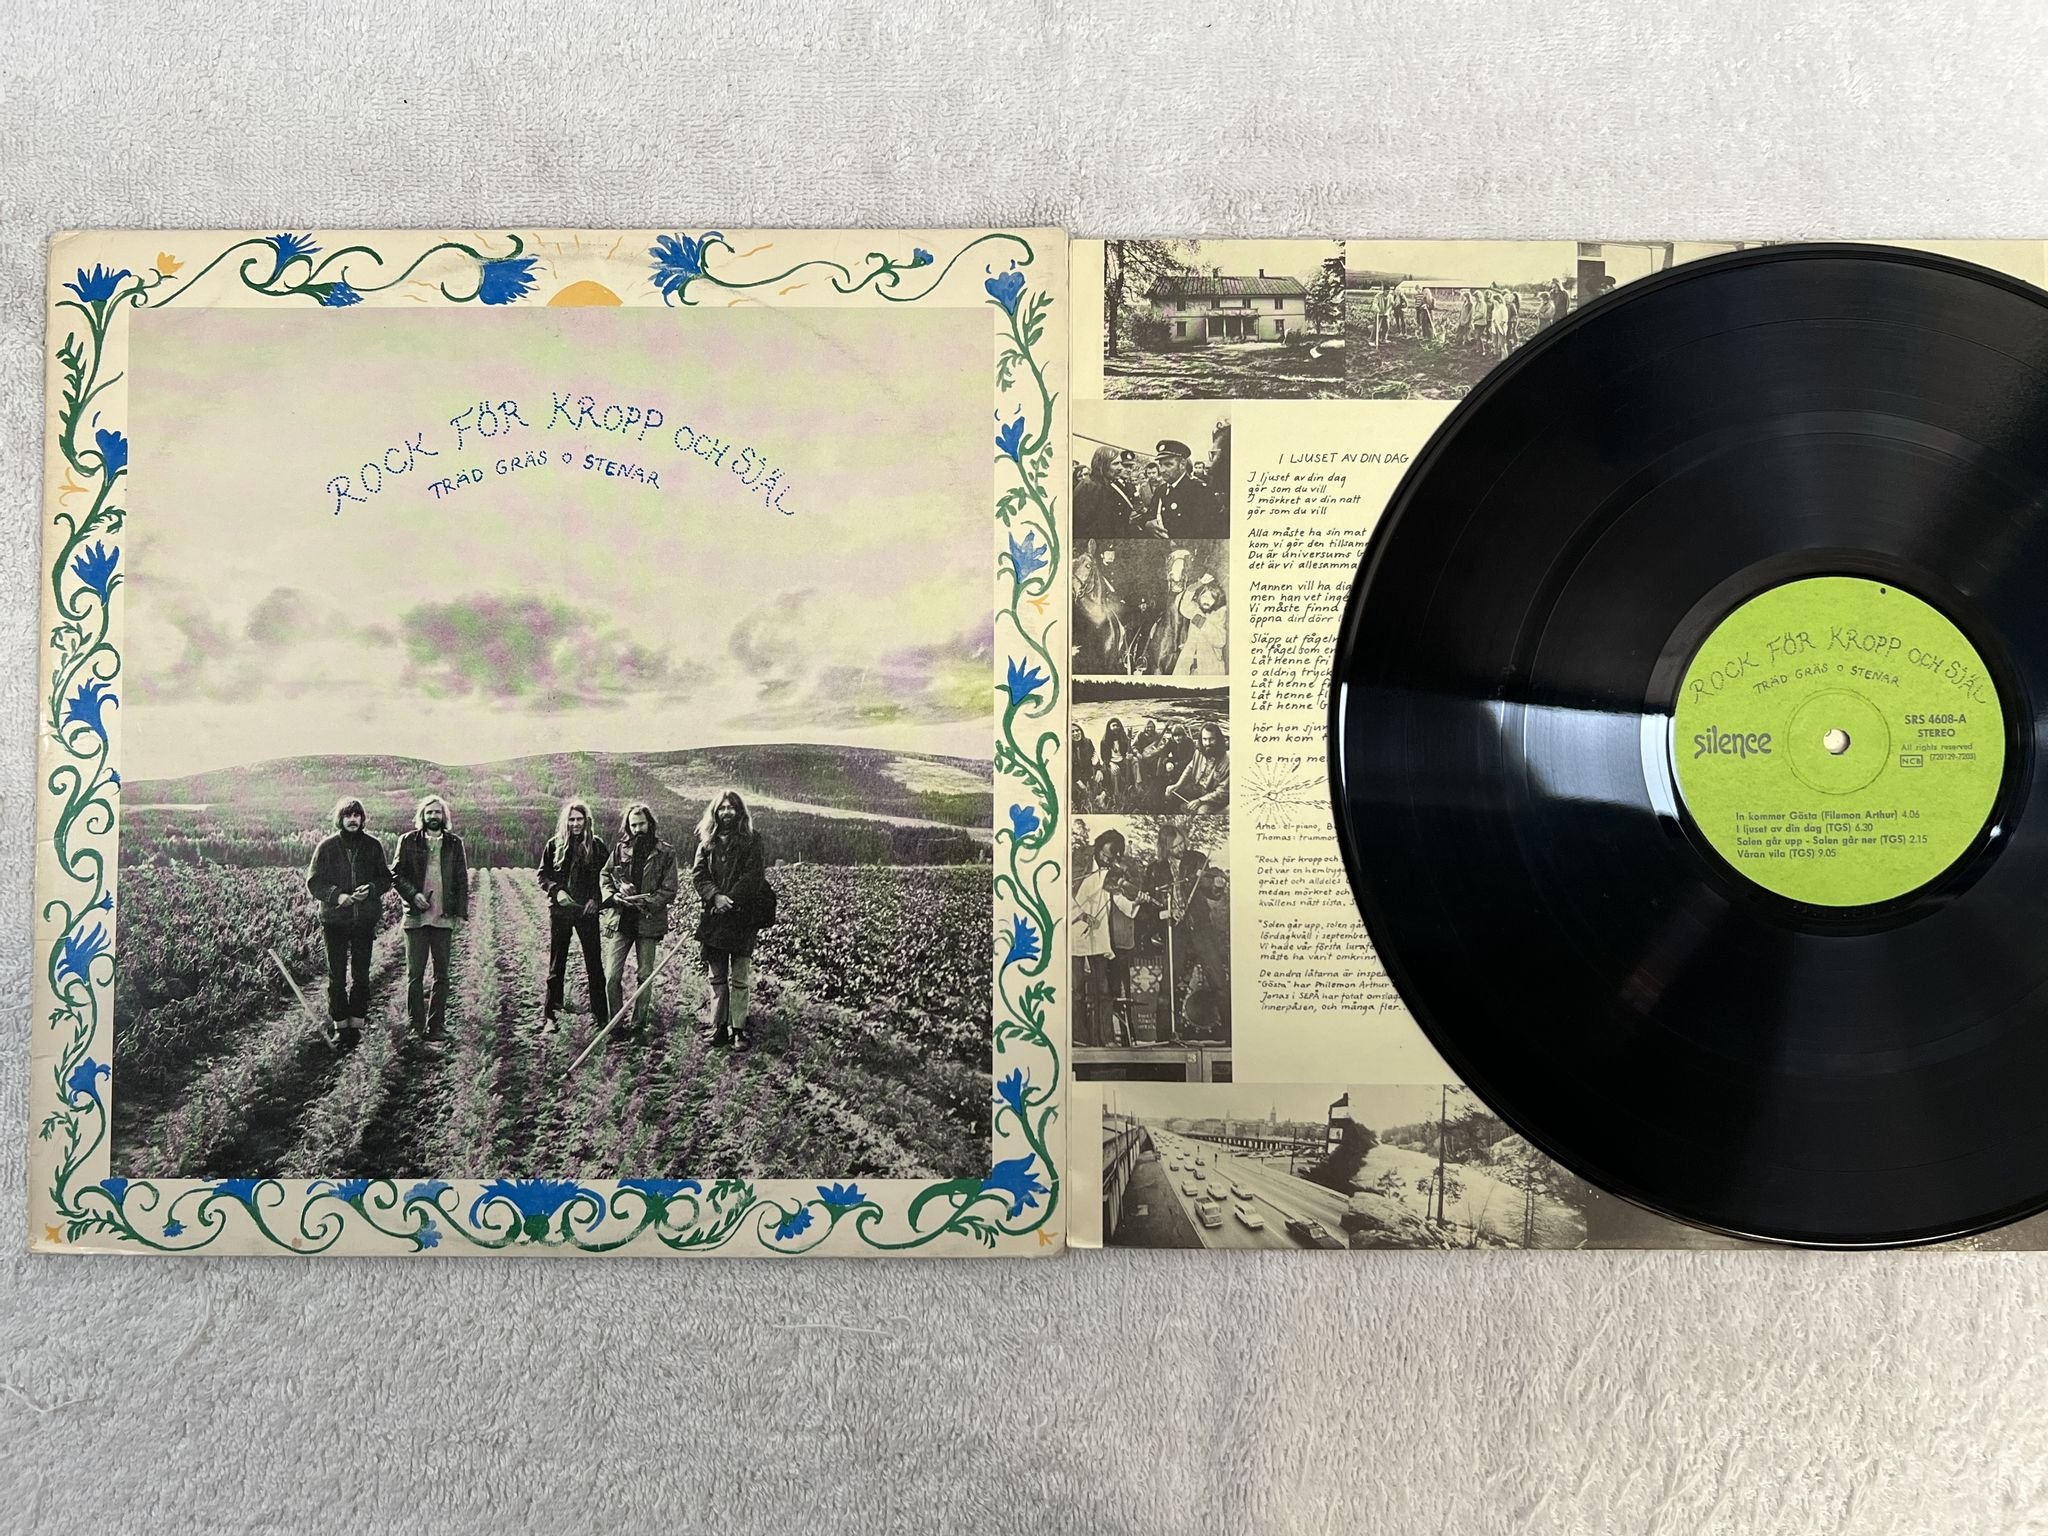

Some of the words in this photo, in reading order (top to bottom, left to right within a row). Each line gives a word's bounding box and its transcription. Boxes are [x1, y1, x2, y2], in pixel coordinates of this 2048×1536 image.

[327, 432, 438, 515] ROCK
[449, 400, 529, 450] FÖR
[547, 392, 664, 440] KROPP
[673, 426, 730, 467] OCH
[731, 447, 795, 515] SJÄL
[1290, 453, 1338, 464] LJUSET
[1341, 453, 1357, 463] AV
[1360, 453, 1381, 463] DIN
[1384, 453, 1409, 464] DAG
[427, 468, 484, 500] TRÄD
[495, 450, 547, 475] GRÄS
[582, 454, 660, 490] STENAR
[1260, 472, 1290, 485] ljuset
[1307, 472, 1324, 482] din
[1328, 472, 1346, 488] dag
[1248, 484, 1267, 495] gör
[1294, 485, 1308, 493] du
[1310, 485, 1327, 493] vill
[1258, 496, 1301, 504] mörkret
[1320, 495, 1336, 503] din
[1339, 495, 1361, 503] natt
[1246, 506, 1266, 520] gör
[1293, 506, 1307, 515] du
[1311, 506, 1327, 515] vill
[1248, 528, 1269, 537] Alla
[1272, 526, 1305, 537] måste
[1309, 527, 1322, 537] ha
[1326, 528, 1340, 537] sin
[1343, 527, 1367, 537] mat
[1249, 540, 1269, 548] kom
[1273, 539, 1284, 548] vi
[1286, 538, 1304, 553] gör
[1307, 539, 1324, 548] den
[1248, 551, 1263, 559] Du
[1266, 549, 1278, 559] är
[1282, 549, 1352, 558] universums
[1248, 561, 1265, 569] det
[1267, 560, 1280, 569] är
[1283, 560, 1294, 569] vi
[1249, 581, 1293, 591] Mannen
[1298, 580, 1314, 591] vill
[1317, 580, 1331, 591] ha
[1281, 593, 1300, 601] han
[1304, 593, 1322, 601] vet
[1250, 603, 1260, 612] Vi
[1264, 602, 1300, 612] måste
[1304, 603, 1339, 618] finna
[1250, 614, 1282, 628] öppna
[1308, 614, 1334, 623] dörr
[1251, 633, 1282, 648] Släpp
[1285, 635, 1298, 643] ut
[1299, 647, 1320, 655] som
[1251, 655, 1272, 665] Låt
[1274, 657, 1311, 665] henne
[1689, 652, 1759, 704] ROCK
[1766, 631, 1816, 664] FÖR
[1830, 626, 1902, 658] KROPP
[1907, 648, 1943, 673] OCH
[1945, 660, 1986, 704] SJÄL
[1262, 667, 1296, 682] aldrig
[1753, 674, 1788, 694] TRÄD
[1795, 663, 1828, 680] GRÄS
[1850, 665, 1901, 687] STENAR
[1251, 677, 1273, 688] Låt
[1277, 679, 1315, 688] henne
[1251, 689, 1271, 700] Låt
[1276, 691, 1313, 699] henne
[1251, 701, 1272, 711] Låt
[1277, 702, 1313, 710] henne
[1904, 715, 1925, 724] SRS
[1928, 714, 1967, 724] 4608-A
[1253, 722, 1273, 733] hör
[1277, 722, 1299, 732] hon
[1918, 729, 1956, 737] STEREO
[1254, 733, 1280, 743] kom
[1285, 734, 1314, 743] kom
[1694, 725, 1772, 759] silence
[1916, 744, 1937, 752] rights
[1255, 753, 1272, 763] Ge
[1277, 753, 1302, 773] mig
[1736, 812, 1744, 821] In
[1749, 812, 1786, 821] kommer
[1789, 811, 1817, 820] Gösta
[1821, 811, 1861, 821] (Filemon
[1865, 810, 1898, 821] Arthur)
[1902, 810, 1920, 819] 4.06
[1743, 825, 1767, 835] ljuset
[1785, 824, 1800, 833] din
[1803, 823, 1822, 834] dag
[1825, 823, 1851, 834] (TGS)
[1855, 823, 1873, 832] 6.30
[1736, 837, 1762, 846] Solen
[1765, 836, 1781, 847] går
[1785, 838, 1803, 847] upp
[1812, 836, 1839, 845] Solen
[1842, 835, 1858, 847] går
[1861, 837, 1877, 845] ner
[1880, 835, 1906, 846] (TGS)
[1909, 835, 1928, 844] 2.15
[1737, 849, 1765, 859] Våran
[1769, 849, 1786, 858] vila
[1789, 848, 1815, 859] (TGS)
[1818, 849, 1837, 858] 9.05
[1257, 867, 1273, 875] Det
